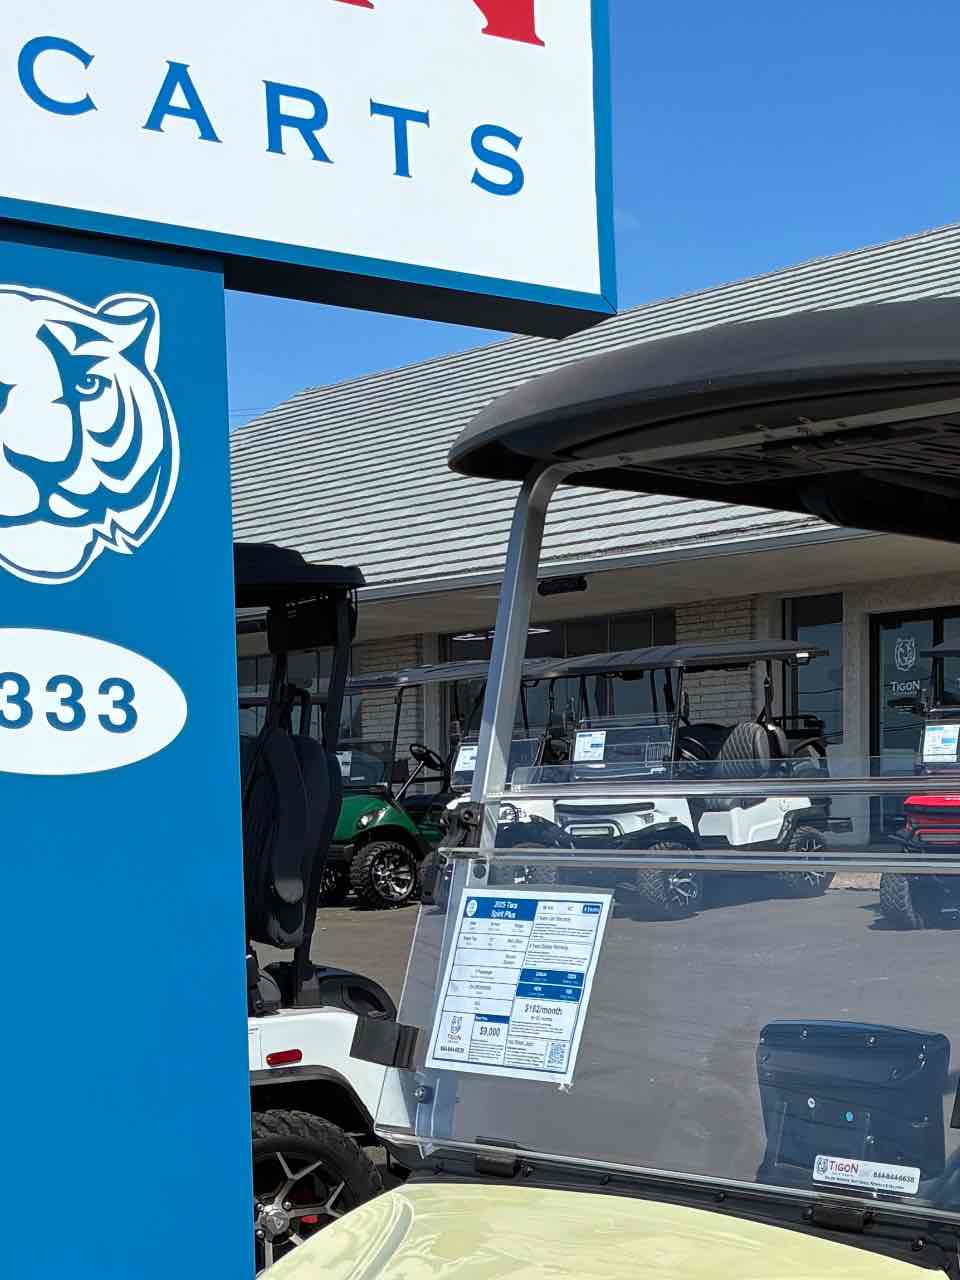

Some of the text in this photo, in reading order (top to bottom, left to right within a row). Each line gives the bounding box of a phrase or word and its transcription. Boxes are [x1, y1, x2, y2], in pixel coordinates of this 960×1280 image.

[17, 35, 525, 197] CARTS
[890, 680, 920, 692] TIGON
[829, 1160, 859, 1174] TIGON
